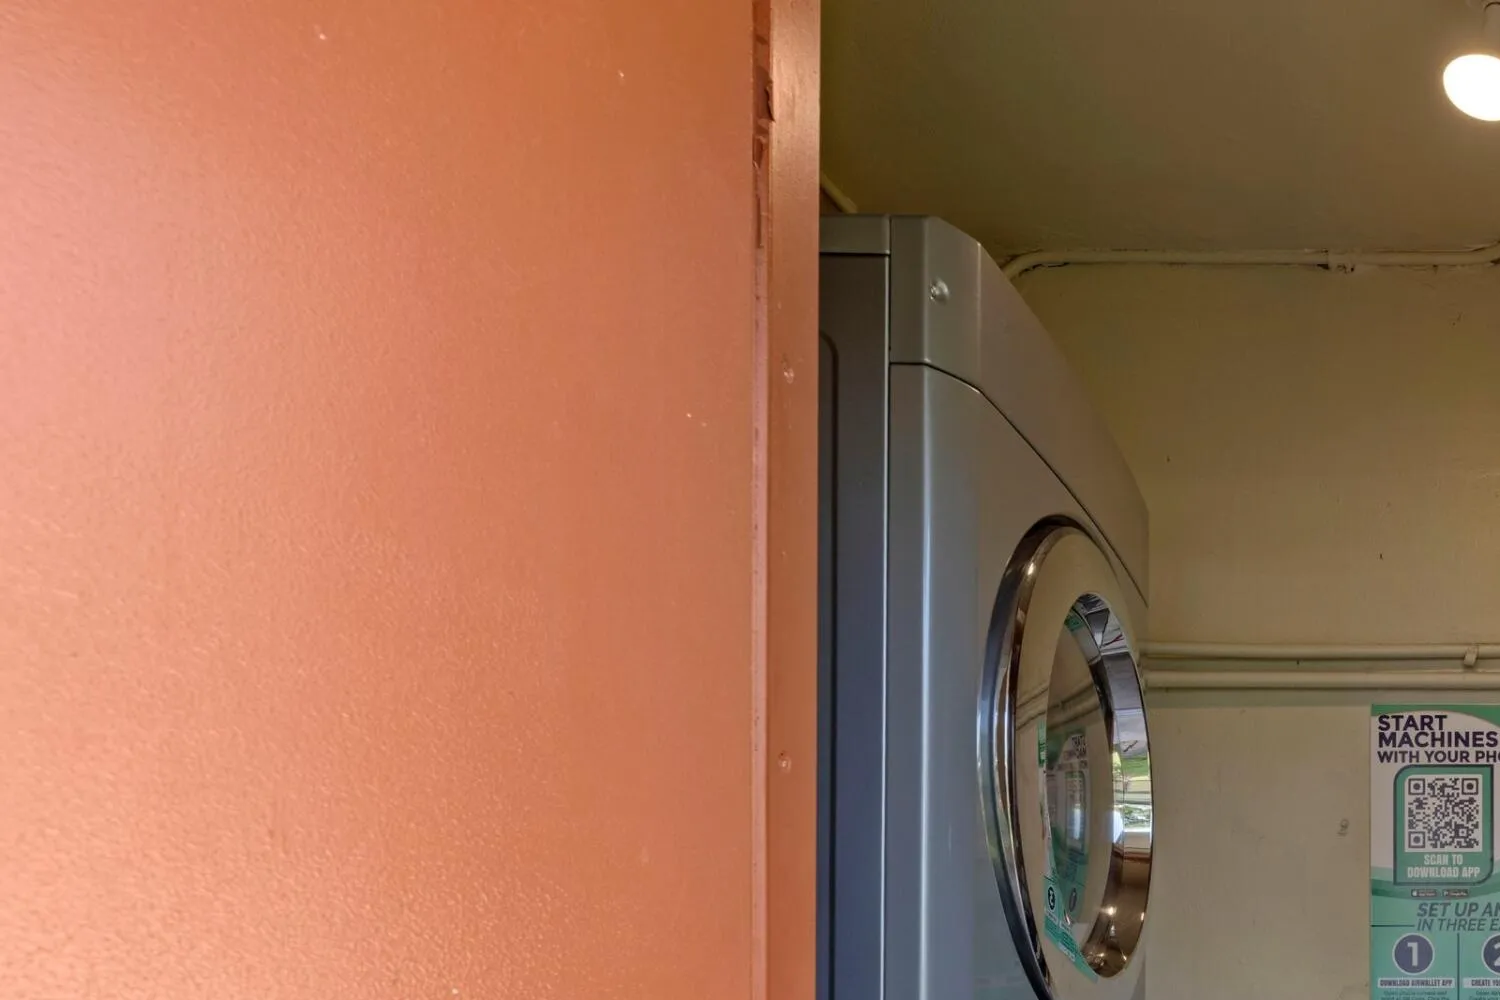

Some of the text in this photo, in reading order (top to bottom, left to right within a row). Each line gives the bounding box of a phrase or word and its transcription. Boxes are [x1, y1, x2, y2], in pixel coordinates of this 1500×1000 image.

[1377, 714, 1448, 732] START
[1377, 731, 1499, 748] MACHINES
[1377, 750, 1420, 763] WITH
[1424, 750, 1472, 763] YOUR
[1423, 853, 1464, 865] SCAN TO
[1407, 866, 1481, 878] DOWNLOAD APP
[1417, 902, 1451, 918] SET
[1454, 902, 1479, 918] UP
[1416, 918, 1435, 932] IN
[1437, 918, 1486, 932] THREE
[1407, 941, 1419, 967] 1
[1471, 979, 1491, 987] CREATE
